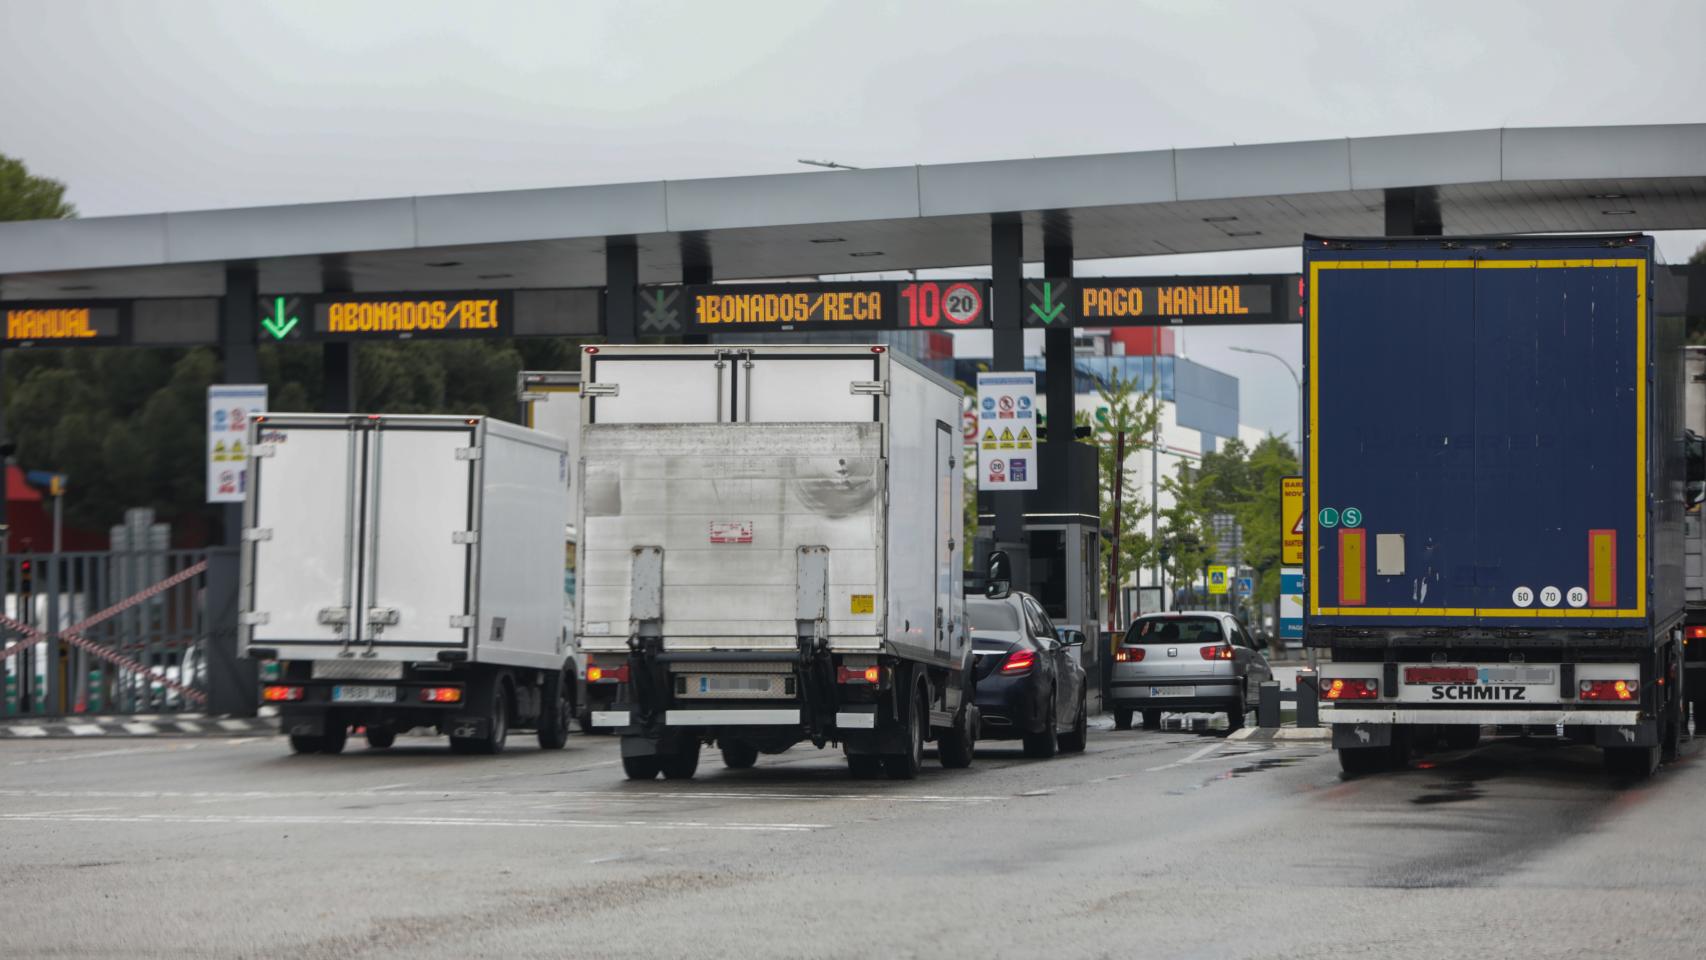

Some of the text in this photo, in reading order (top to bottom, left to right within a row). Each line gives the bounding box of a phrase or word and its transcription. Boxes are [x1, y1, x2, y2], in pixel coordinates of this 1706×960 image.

[901, 282, 940, 328] 10
[949, 295, 973, 313] 20
[1083, 285, 1249, 317] PAGO MANUAL
[7, 308, 97, 340] MANUAL
[1431, 686, 1526, 700] SCHMITZ
